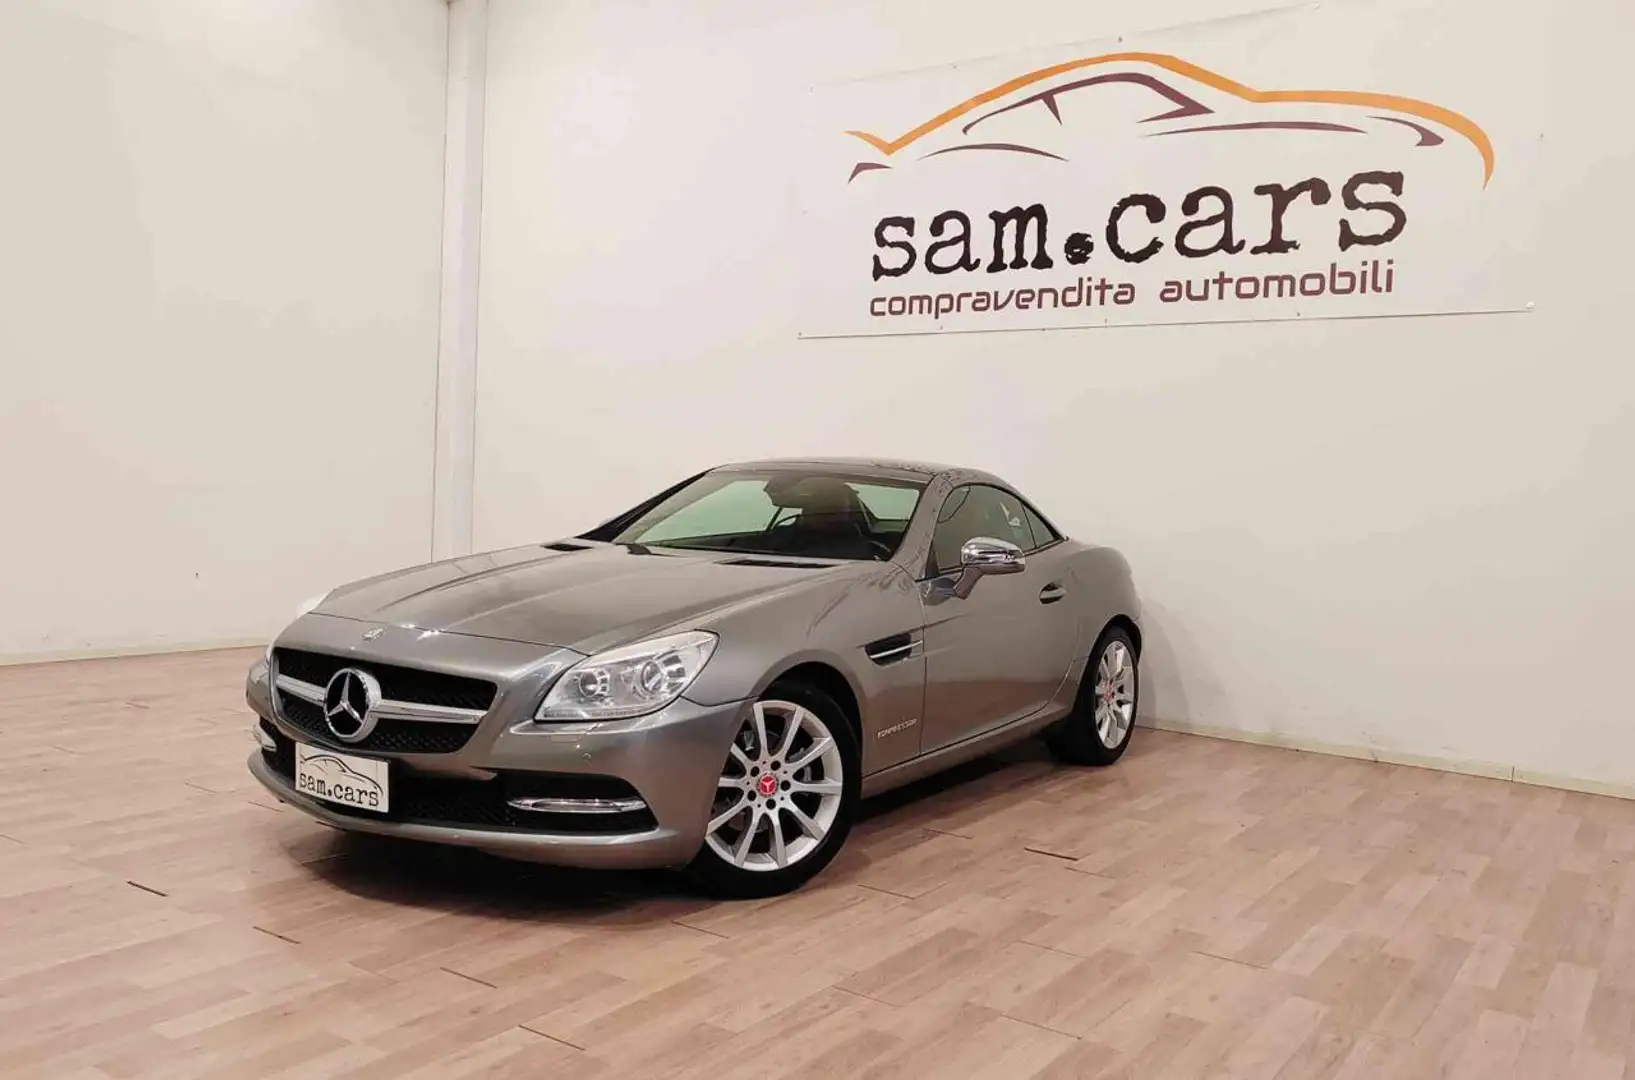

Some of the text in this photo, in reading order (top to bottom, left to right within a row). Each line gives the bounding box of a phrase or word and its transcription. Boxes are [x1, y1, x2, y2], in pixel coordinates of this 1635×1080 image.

[872, 170, 1407, 282] sam.cars
[870, 260, 1393, 320] compravendita automobili
[299, 772, 379, 807] sam.cars
